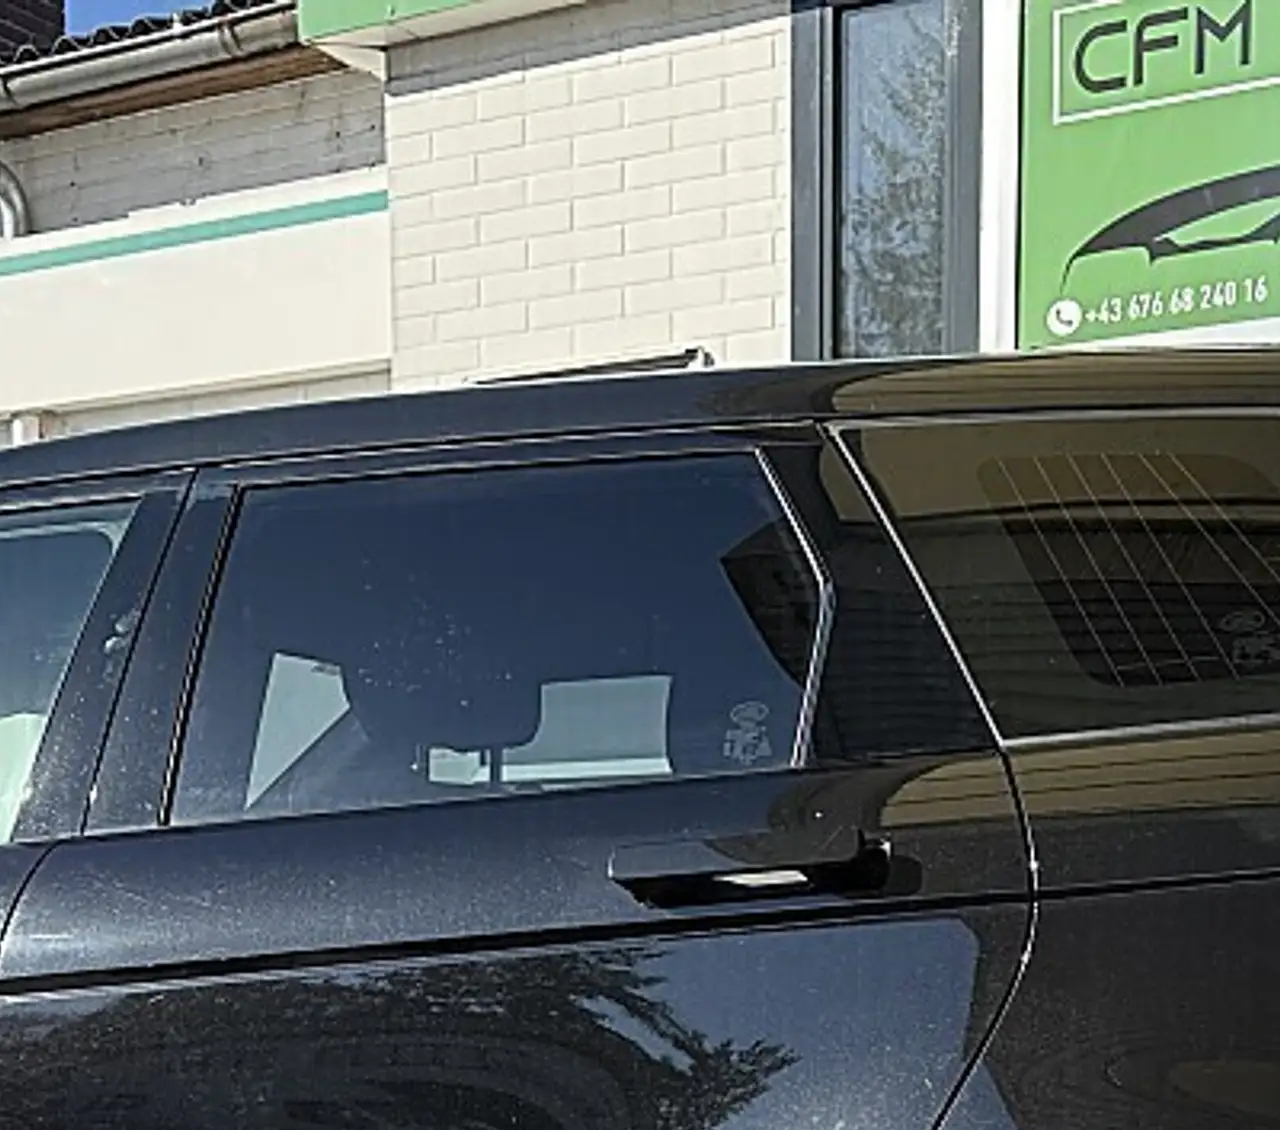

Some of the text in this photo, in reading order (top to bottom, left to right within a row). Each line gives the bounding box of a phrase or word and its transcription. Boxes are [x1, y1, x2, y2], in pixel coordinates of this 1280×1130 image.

[1074, 0, 1252, 93] CFM
[1085, 297, 1122, 325] +43
[1128, 291, 1163, 320] 676
[1199, 280, 1237, 310] 240
[1244, 275, 1269, 302] 16
